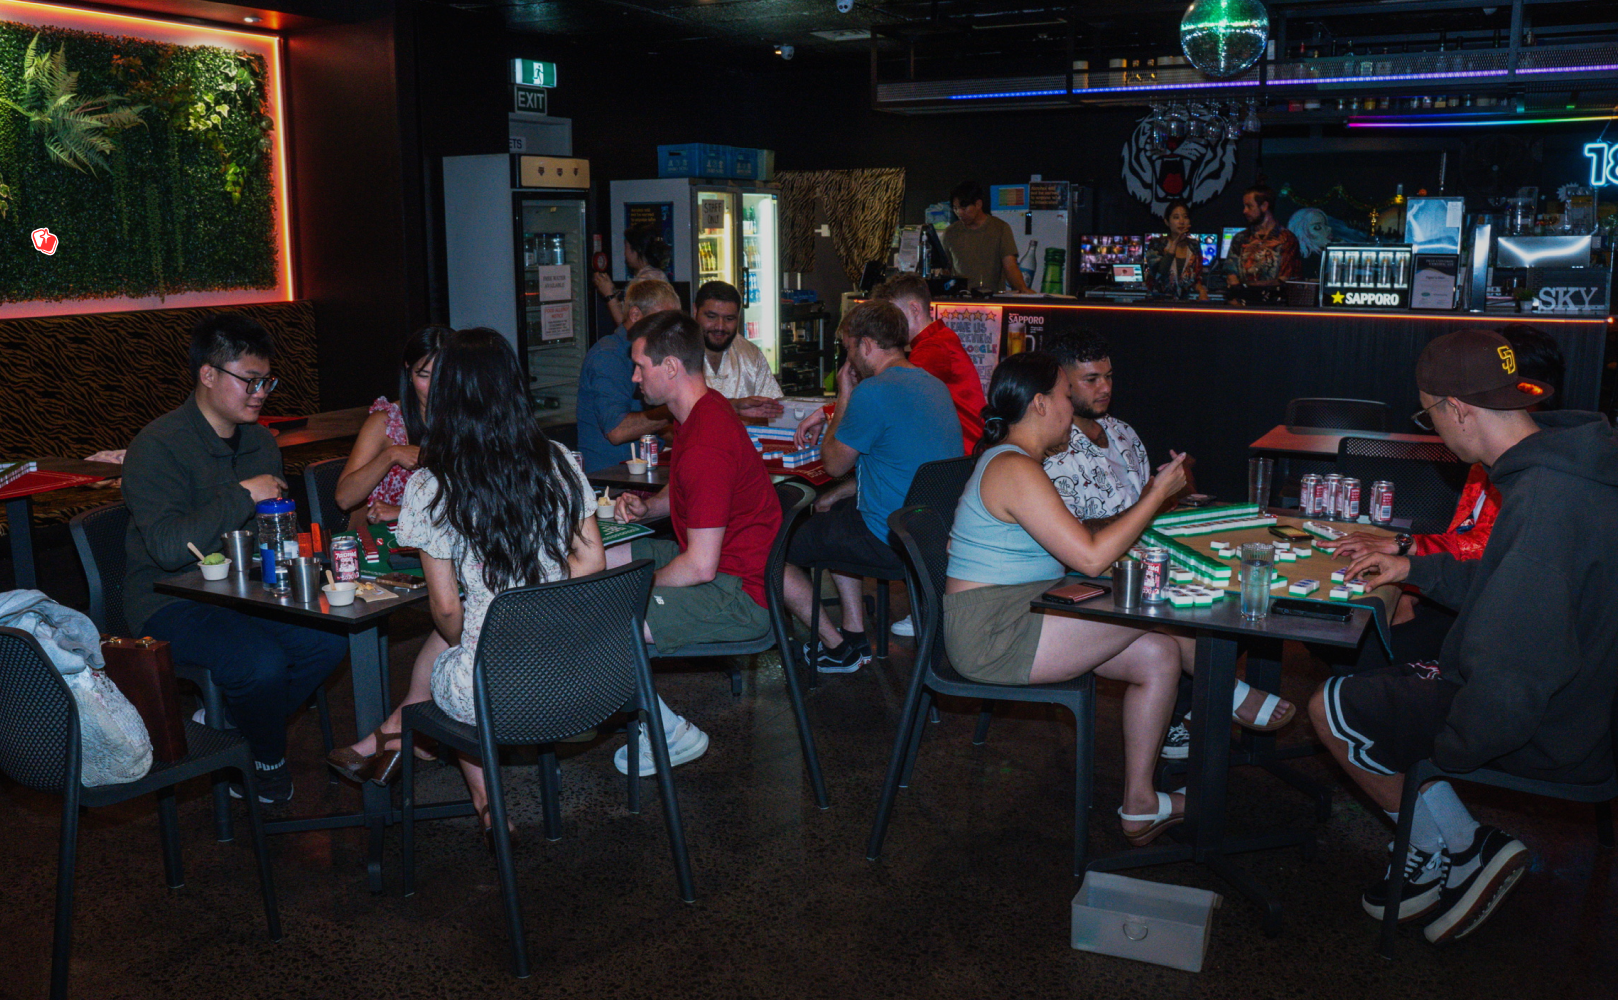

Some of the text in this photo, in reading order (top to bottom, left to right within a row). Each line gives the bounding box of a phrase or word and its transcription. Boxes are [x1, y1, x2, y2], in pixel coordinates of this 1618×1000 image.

[518, 91, 545, 110] EXIT
[1345, 292, 1400, 306] SAPPORO
[1538, 287, 1598, 312] SKY
[1008, 315, 1045, 325] SAPPORO
